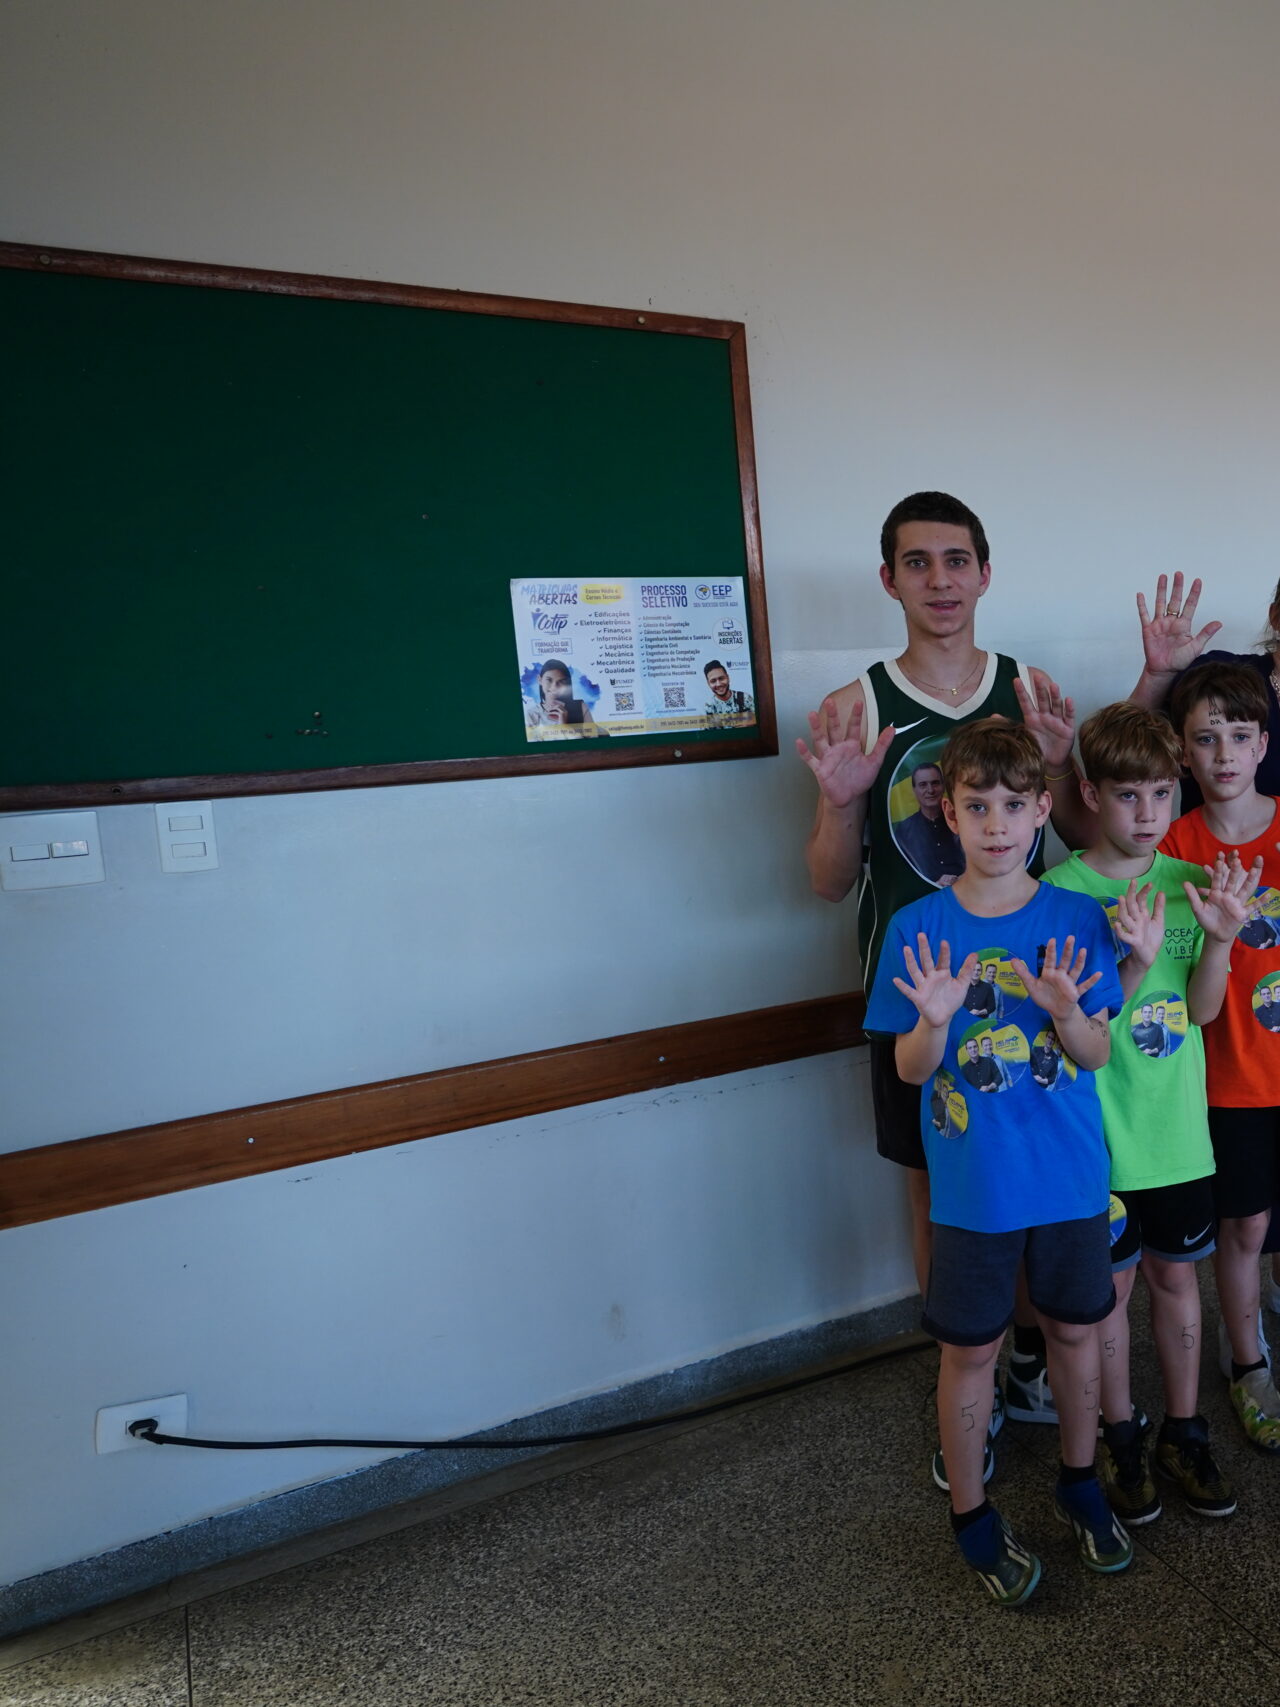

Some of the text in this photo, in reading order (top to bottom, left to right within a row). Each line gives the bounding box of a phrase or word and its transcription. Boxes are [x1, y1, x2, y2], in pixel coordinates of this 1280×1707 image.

[641, 585, 687, 596] PROCESSO
[712, 585, 732, 596] EEP
[529, 593, 578, 605] ABERTAS
[642, 596, 688, 608] SELETIVO
[719, 636, 743, 645] ABERTAS
[1165, 928, 1194, 938] OCEA
[1182, 1323, 1197, 1350] 5
[1104, 1338, 1116, 1358] 5
[1084, 1377, 1099, 1411] 5
[961, 1401, 978, 1432] 5
